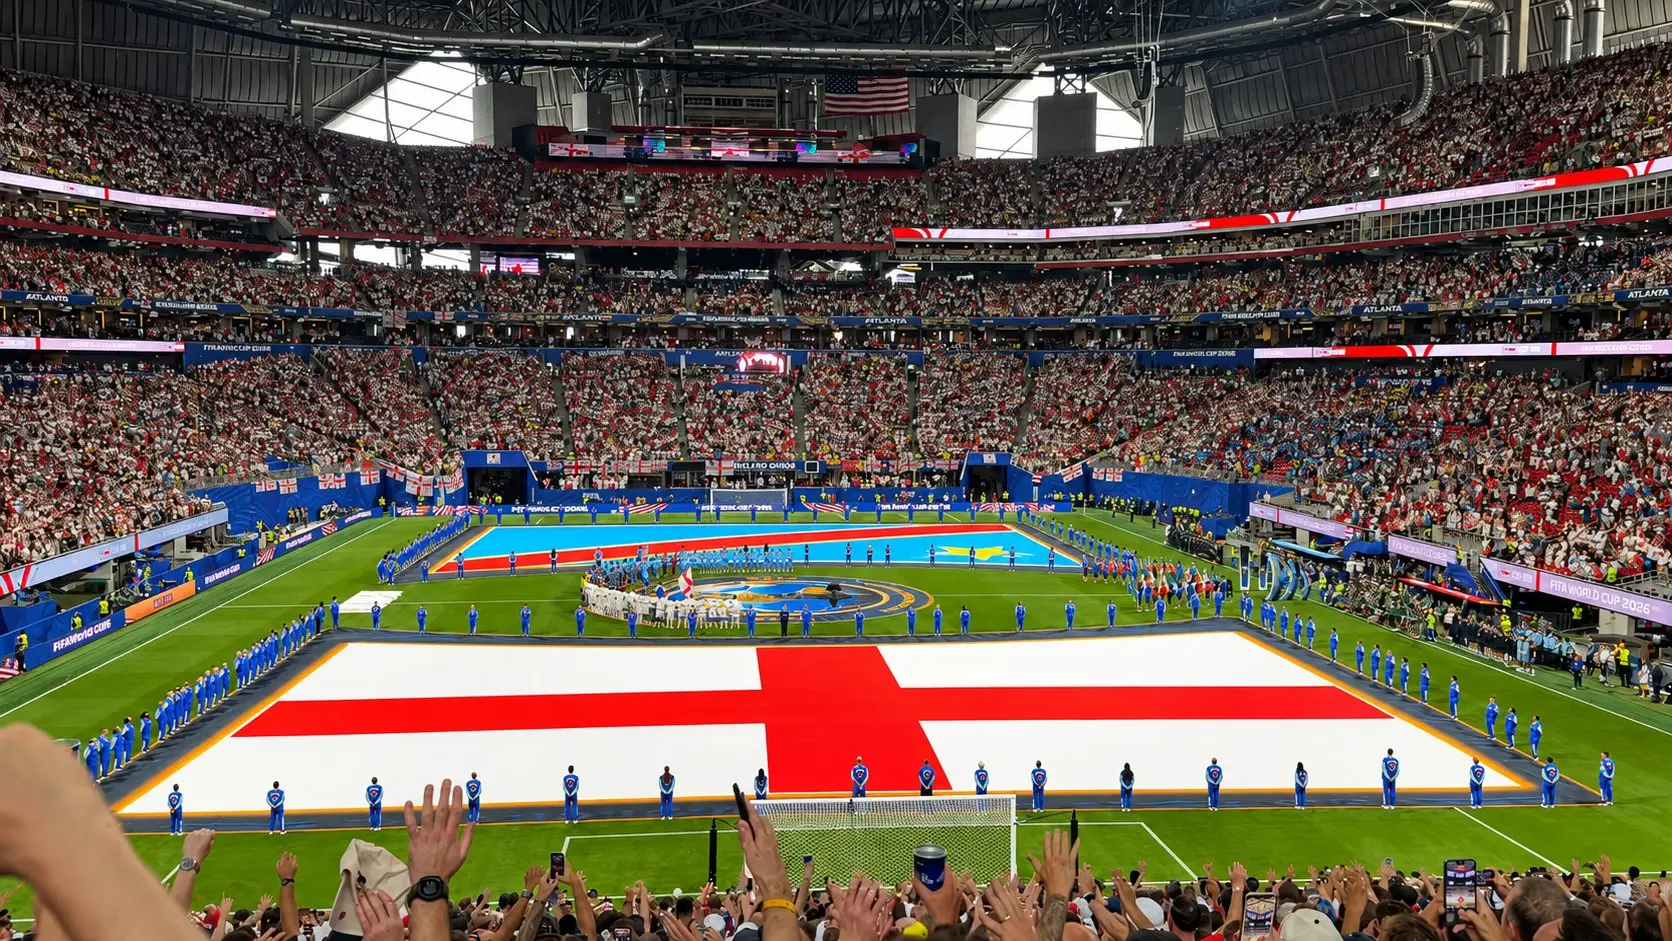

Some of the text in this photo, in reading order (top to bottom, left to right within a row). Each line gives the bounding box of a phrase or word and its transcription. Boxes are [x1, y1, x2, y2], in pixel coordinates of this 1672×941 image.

[1363, 305, 1403, 313] ATLANTA
[1568, 582, 1600, 601] WORLD
[1601, 592, 1621, 606] CUP
[1622, 597, 1650, 615] 2026
